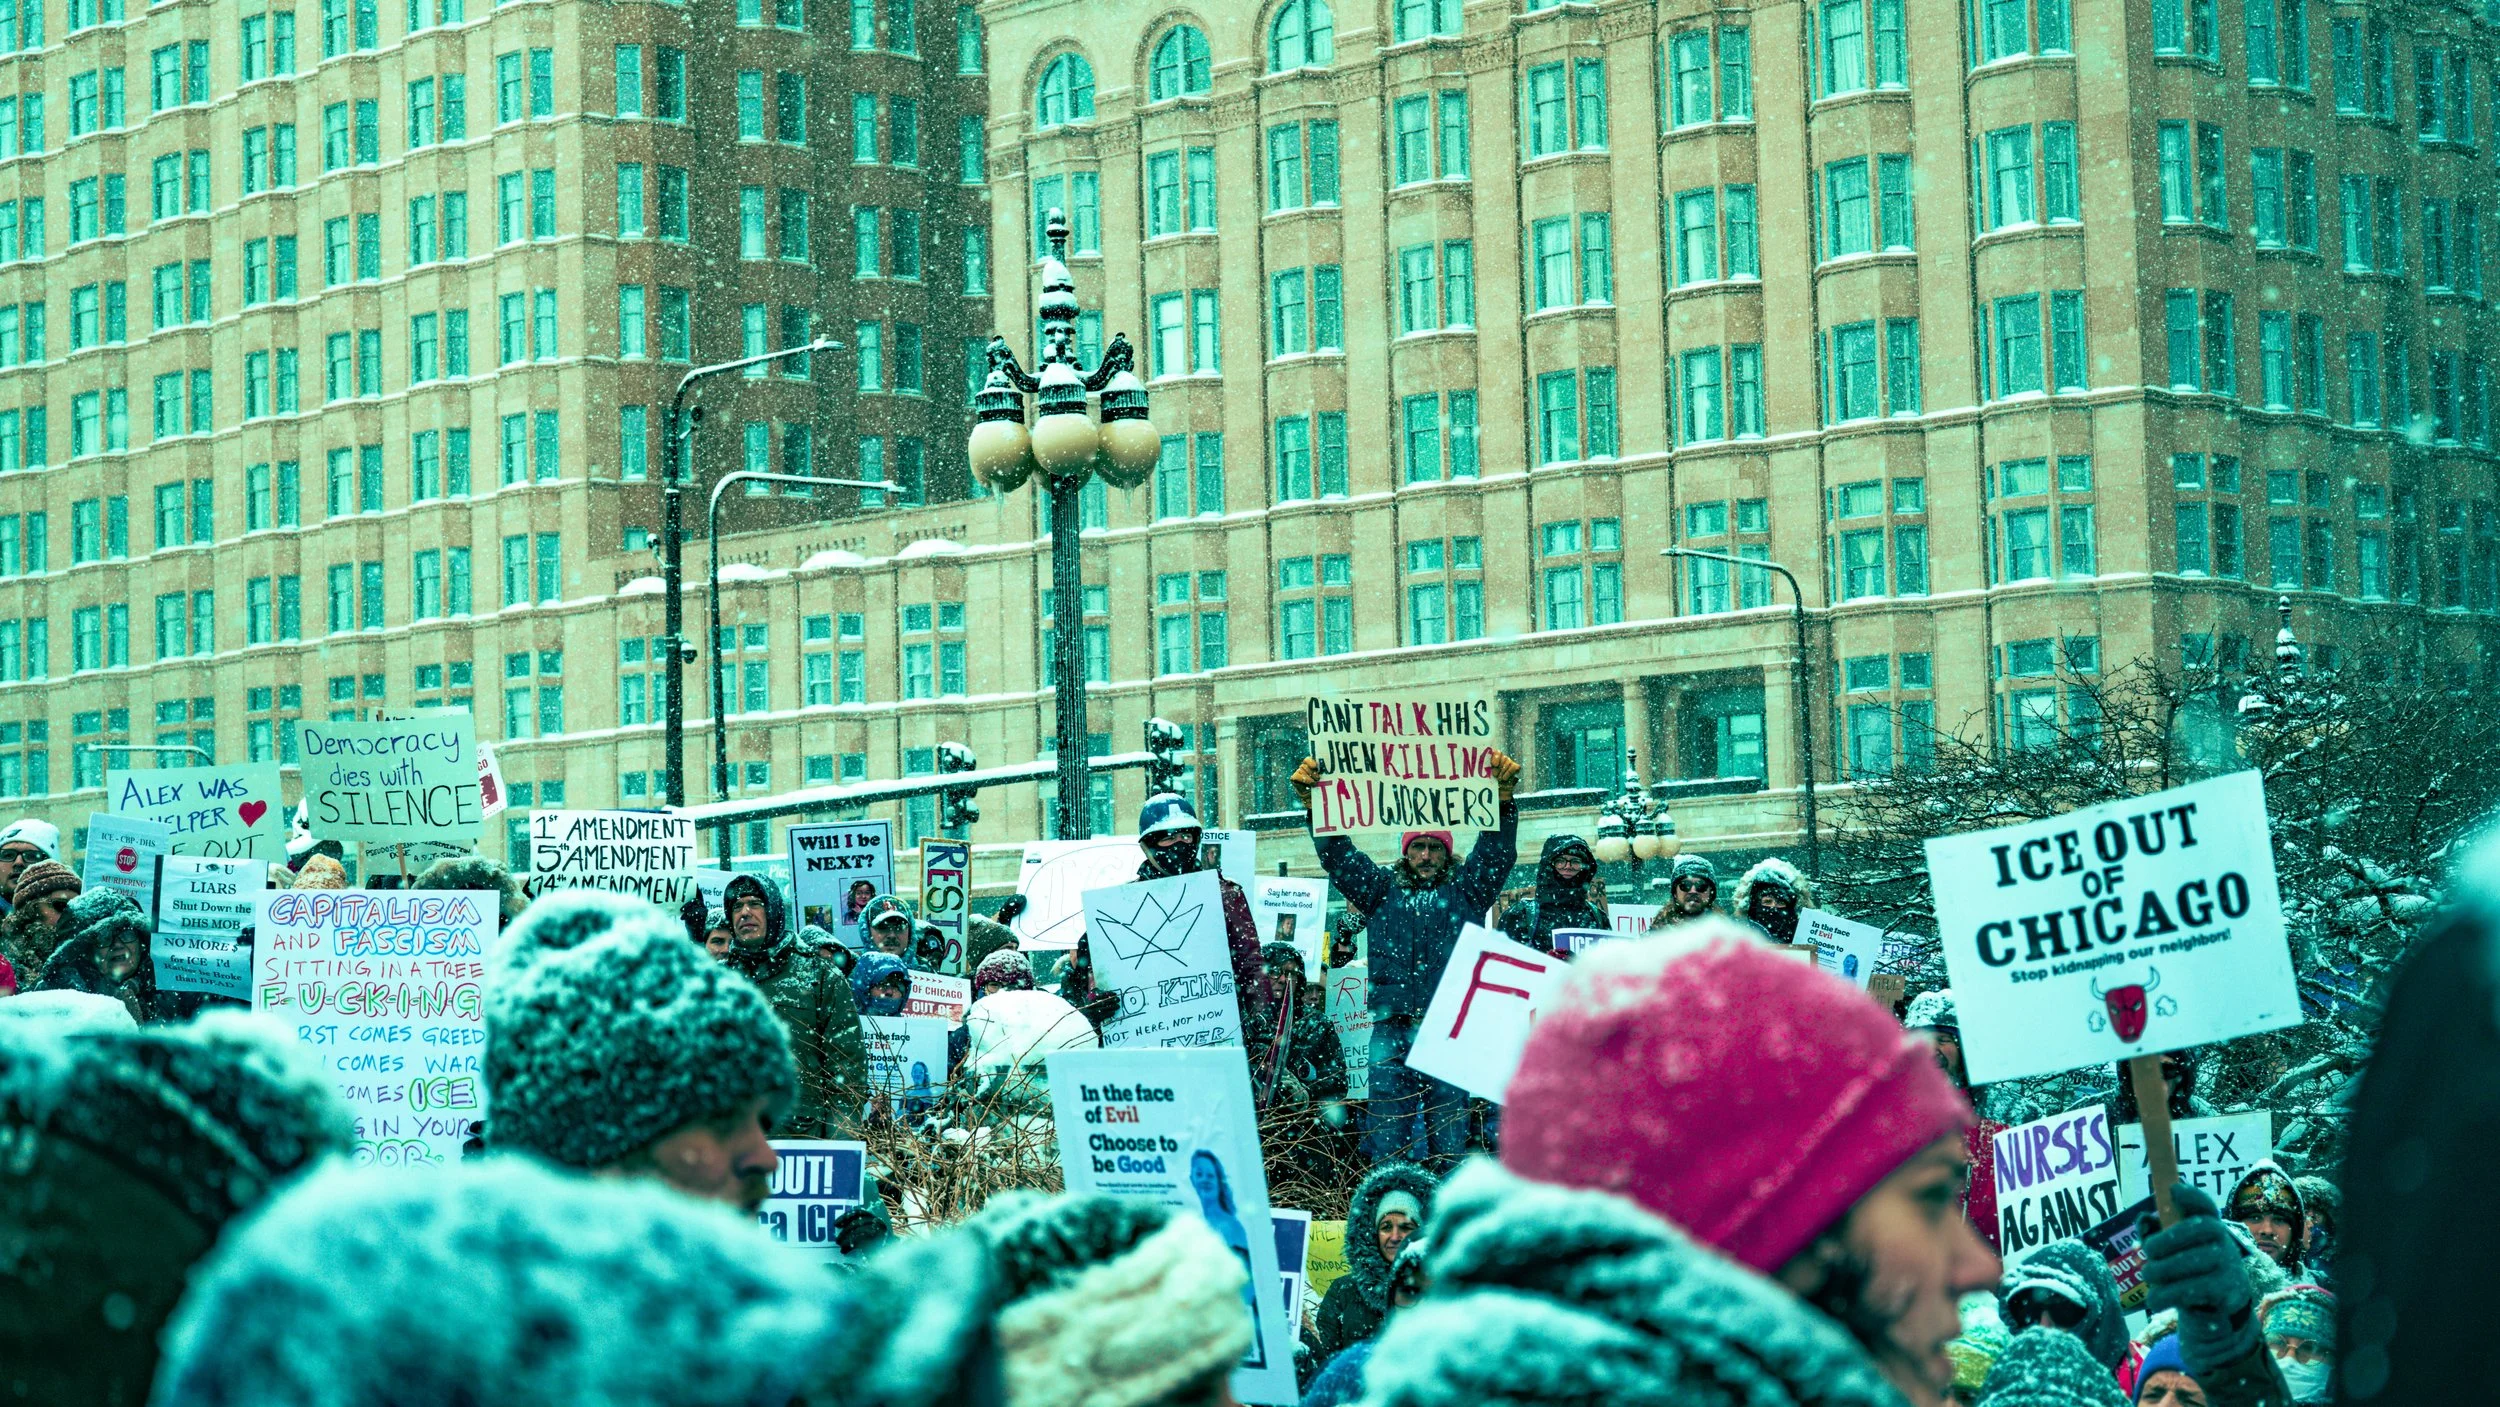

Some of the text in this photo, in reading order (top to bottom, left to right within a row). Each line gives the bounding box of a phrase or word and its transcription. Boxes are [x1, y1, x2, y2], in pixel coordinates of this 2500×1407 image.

[1369, 702, 1433, 736] TALK
[1436, 700, 1490, 736] HHS
[304, 729, 460, 763] Democracy
[1310, 740, 1493, 780] WHEN KILLING
[329, 757, 424, 786] dies with
[120, 777, 248, 811] ALEX WAS
[319, 784, 479, 827] SILENCE
[1314, 777, 1494, 833] ICU WORKERS
[150, 807, 229, 835] ELPER
[566, 816, 692, 842] AMENDMENT
[797, 833, 881, 851] Will I be
[1200, 832, 1230, 841] USTICE
[1991, 802, 2199, 888] ICE OUT
[118, 853, 136, 867] STOP
[561, 844, 693, 872] AMENDMENT
[806, 853, 875, 872] NEXT?
[194, 863, 235, 875] I U
[101, 874, 147, 889] MURDERING
[189, 881, 238, 895] LIARS
[568, 874, 694, 904] AMENDMENT
[2081, 865, 2125, 899] OF
[1267, 888, 1311, 899] Say her name
[172, 900, 252, 914] Shut Down the
[269, 894, 482, 929] CAPITALISM
[927, 845, 969, 974] RESIS
[181, 917, 241, 930] DHS MOB
[1811, 920, 1851, 938] In the face
[1975, 871, 2251, 968] CHICAGO
[163, 937, 187, 948] NO
[188, 938, 229, 952] MORE
[273, 925, 481, 957] AND FASCISM
[1807, 937, 1844, 953] Choose to
[1818, 930, 1834, 940] Evil
[170, 954, 185, 963] for
[186, 956, 208, 967] ICE
[2011, 928, 2233, 984] Stop kidnapping our neighbors!
[213, 971, 242, 981] Broke
[264, 957, 485, 982] SITTING IN A TREE
[925, 986, 963, 999] CHICAGO
[1111, 970, 1233, 1017] O KING
[1447, 950, 1547, 1039] F
[912, 1001, 935, 1013] OUT
[1344, 1011, 1368, 1024] HAVE
[348, 1026, 412, 1043] COMES
[422, 1027, 485, 1047] GREED
[891, 1032, 911, 1041] face
[1103, 1009, 1224, 1047] NOT HERE, NOT NOW
[1344, 1045, 1369, 1058] ENE
[336, 1053, 405, 1074] COMES
[424, 1053, 481, 1074] WAR
[409, 1076, 477, 1113] ICE
[1080, 1083, 1175, 1102] In the face
[1084, 1105, 1140, 1124] of Evil
[374, 1116, 399, 1138] IN
[412, 1115, 479, 1140] YOUR
[1088, 1133, 1179, 1153] Choose to
[2173, 1132, 2240, 1166] LEX
[1091, 1154, 1167, 1174] be Good
[1994, 1113, 2114, 1195] NURSES
[2002, 1179, 2119, 1257] AGAINST
[2117, 1277, 2135, 1293] UT
